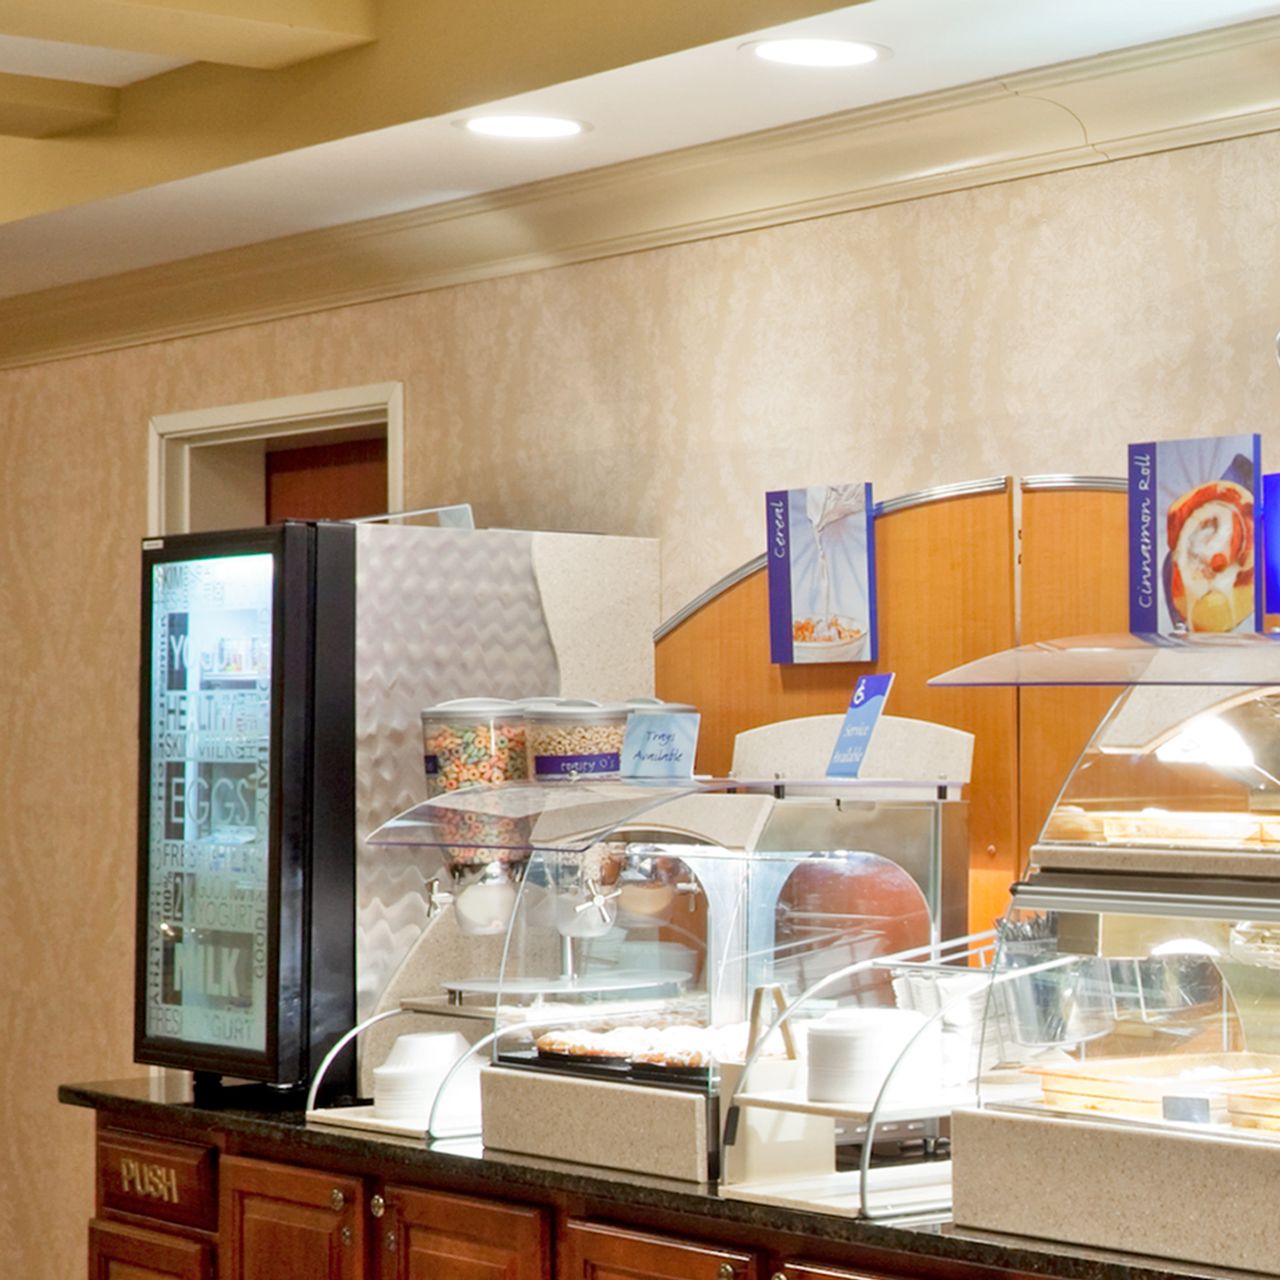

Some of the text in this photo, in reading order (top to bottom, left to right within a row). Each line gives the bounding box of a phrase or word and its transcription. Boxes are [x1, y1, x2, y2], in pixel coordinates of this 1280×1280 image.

[771, 499, 784, 559] Cereal
[1134, 453, 1153, 609] Cinnamon Roll
[632, 748, 683, 763] Available
[646, 730, 676, 747] Trays
[170, 776, 250, 826] EGGS
[120, 1159, 179, 1203] PUSH
